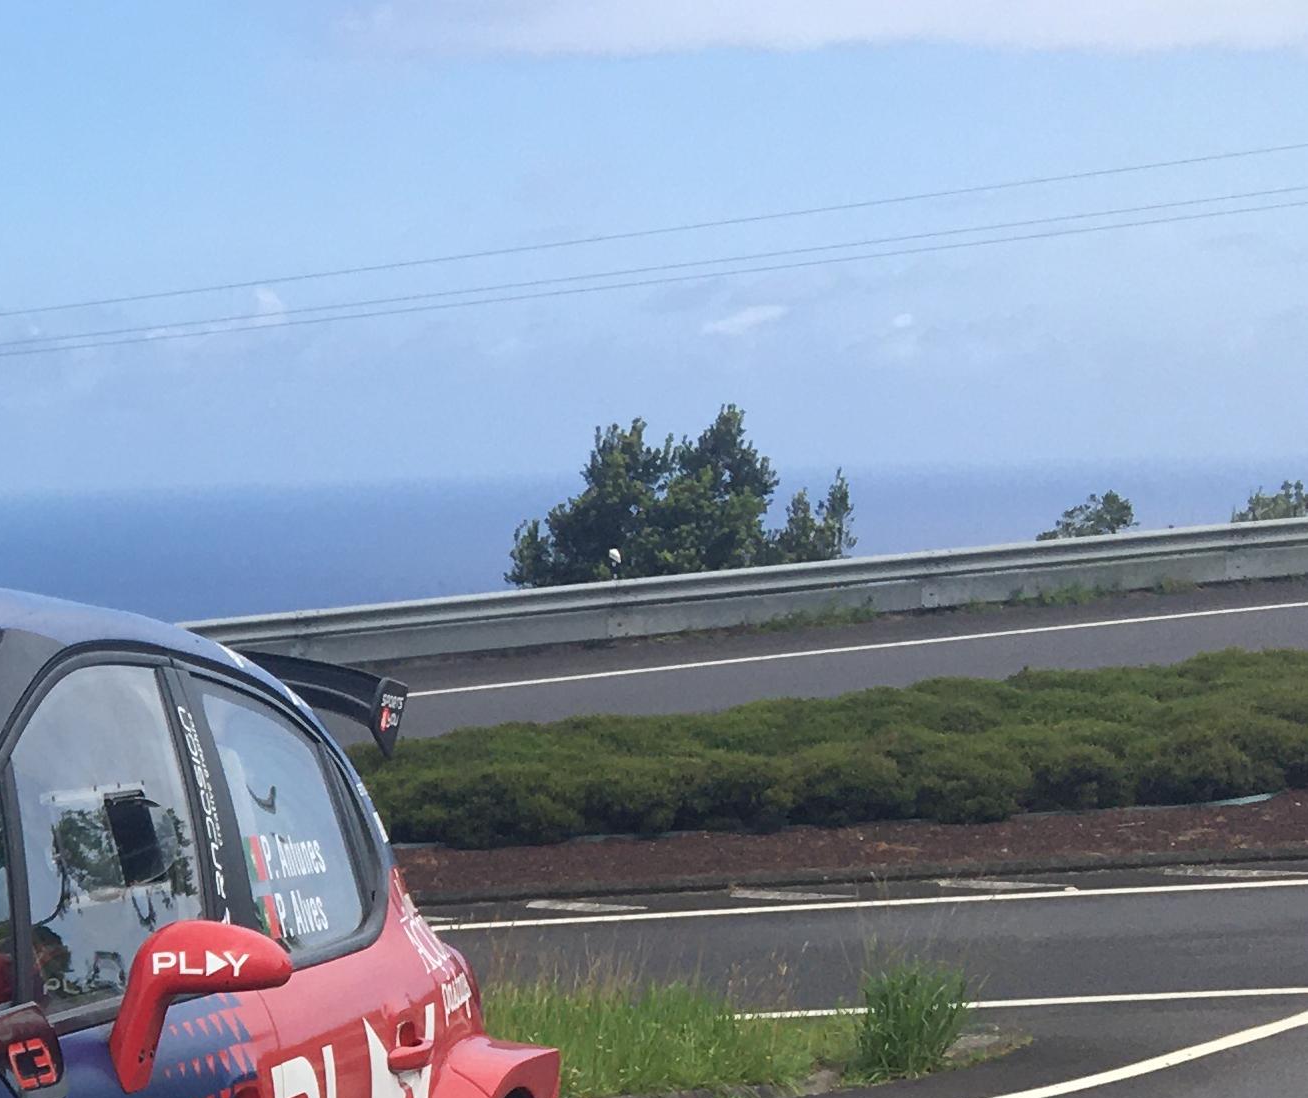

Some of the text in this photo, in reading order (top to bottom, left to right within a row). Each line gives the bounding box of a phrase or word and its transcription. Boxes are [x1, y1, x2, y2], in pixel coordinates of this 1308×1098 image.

[290, 889, 329, 935] Alves
[152, 950, 250, 977] PLAY
[8, 1037, 58, 1091] C3
